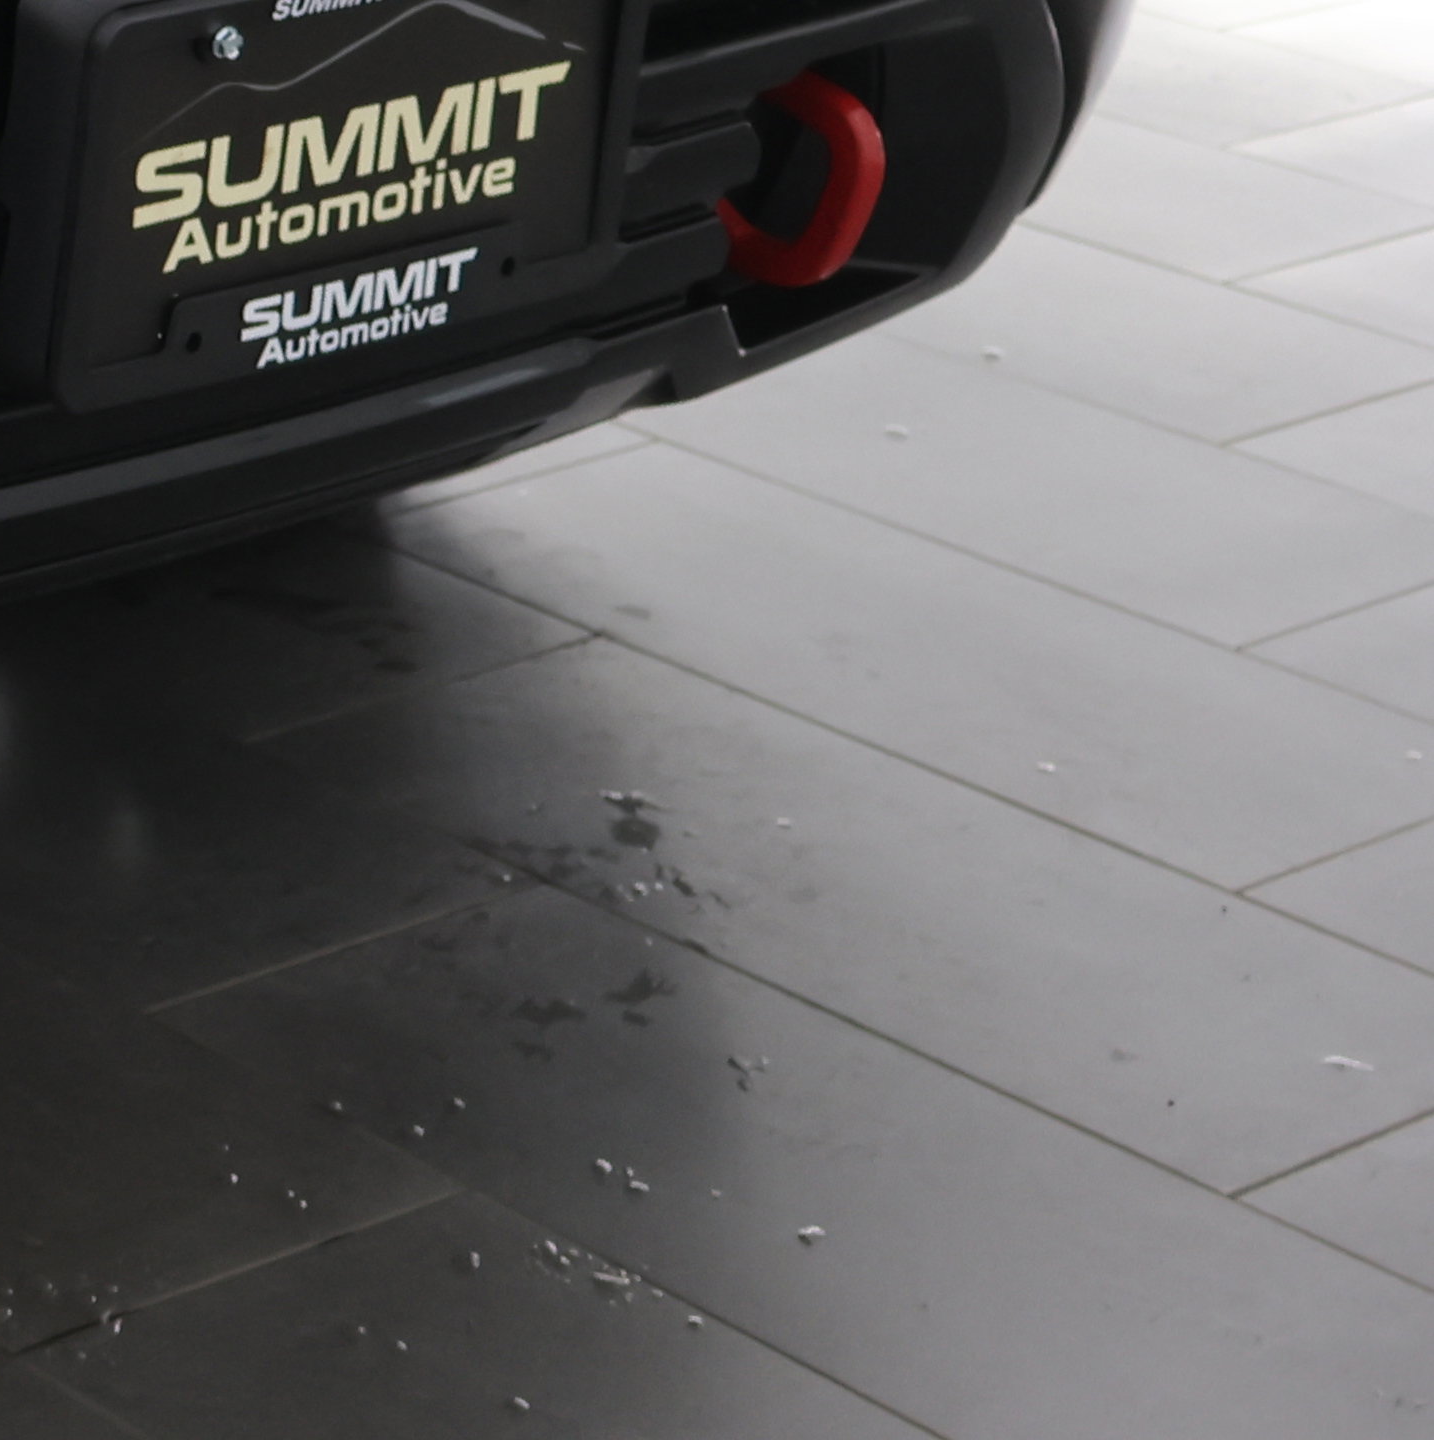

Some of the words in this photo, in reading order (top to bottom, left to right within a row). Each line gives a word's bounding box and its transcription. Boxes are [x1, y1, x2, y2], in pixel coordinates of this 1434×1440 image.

[133, 61, 571, 229] SUMMIT
[162, 156, 516, 273] Automotive
[240, 247, 479, 342] SUMMIT
[256, 302, 448, 370] Automotive
